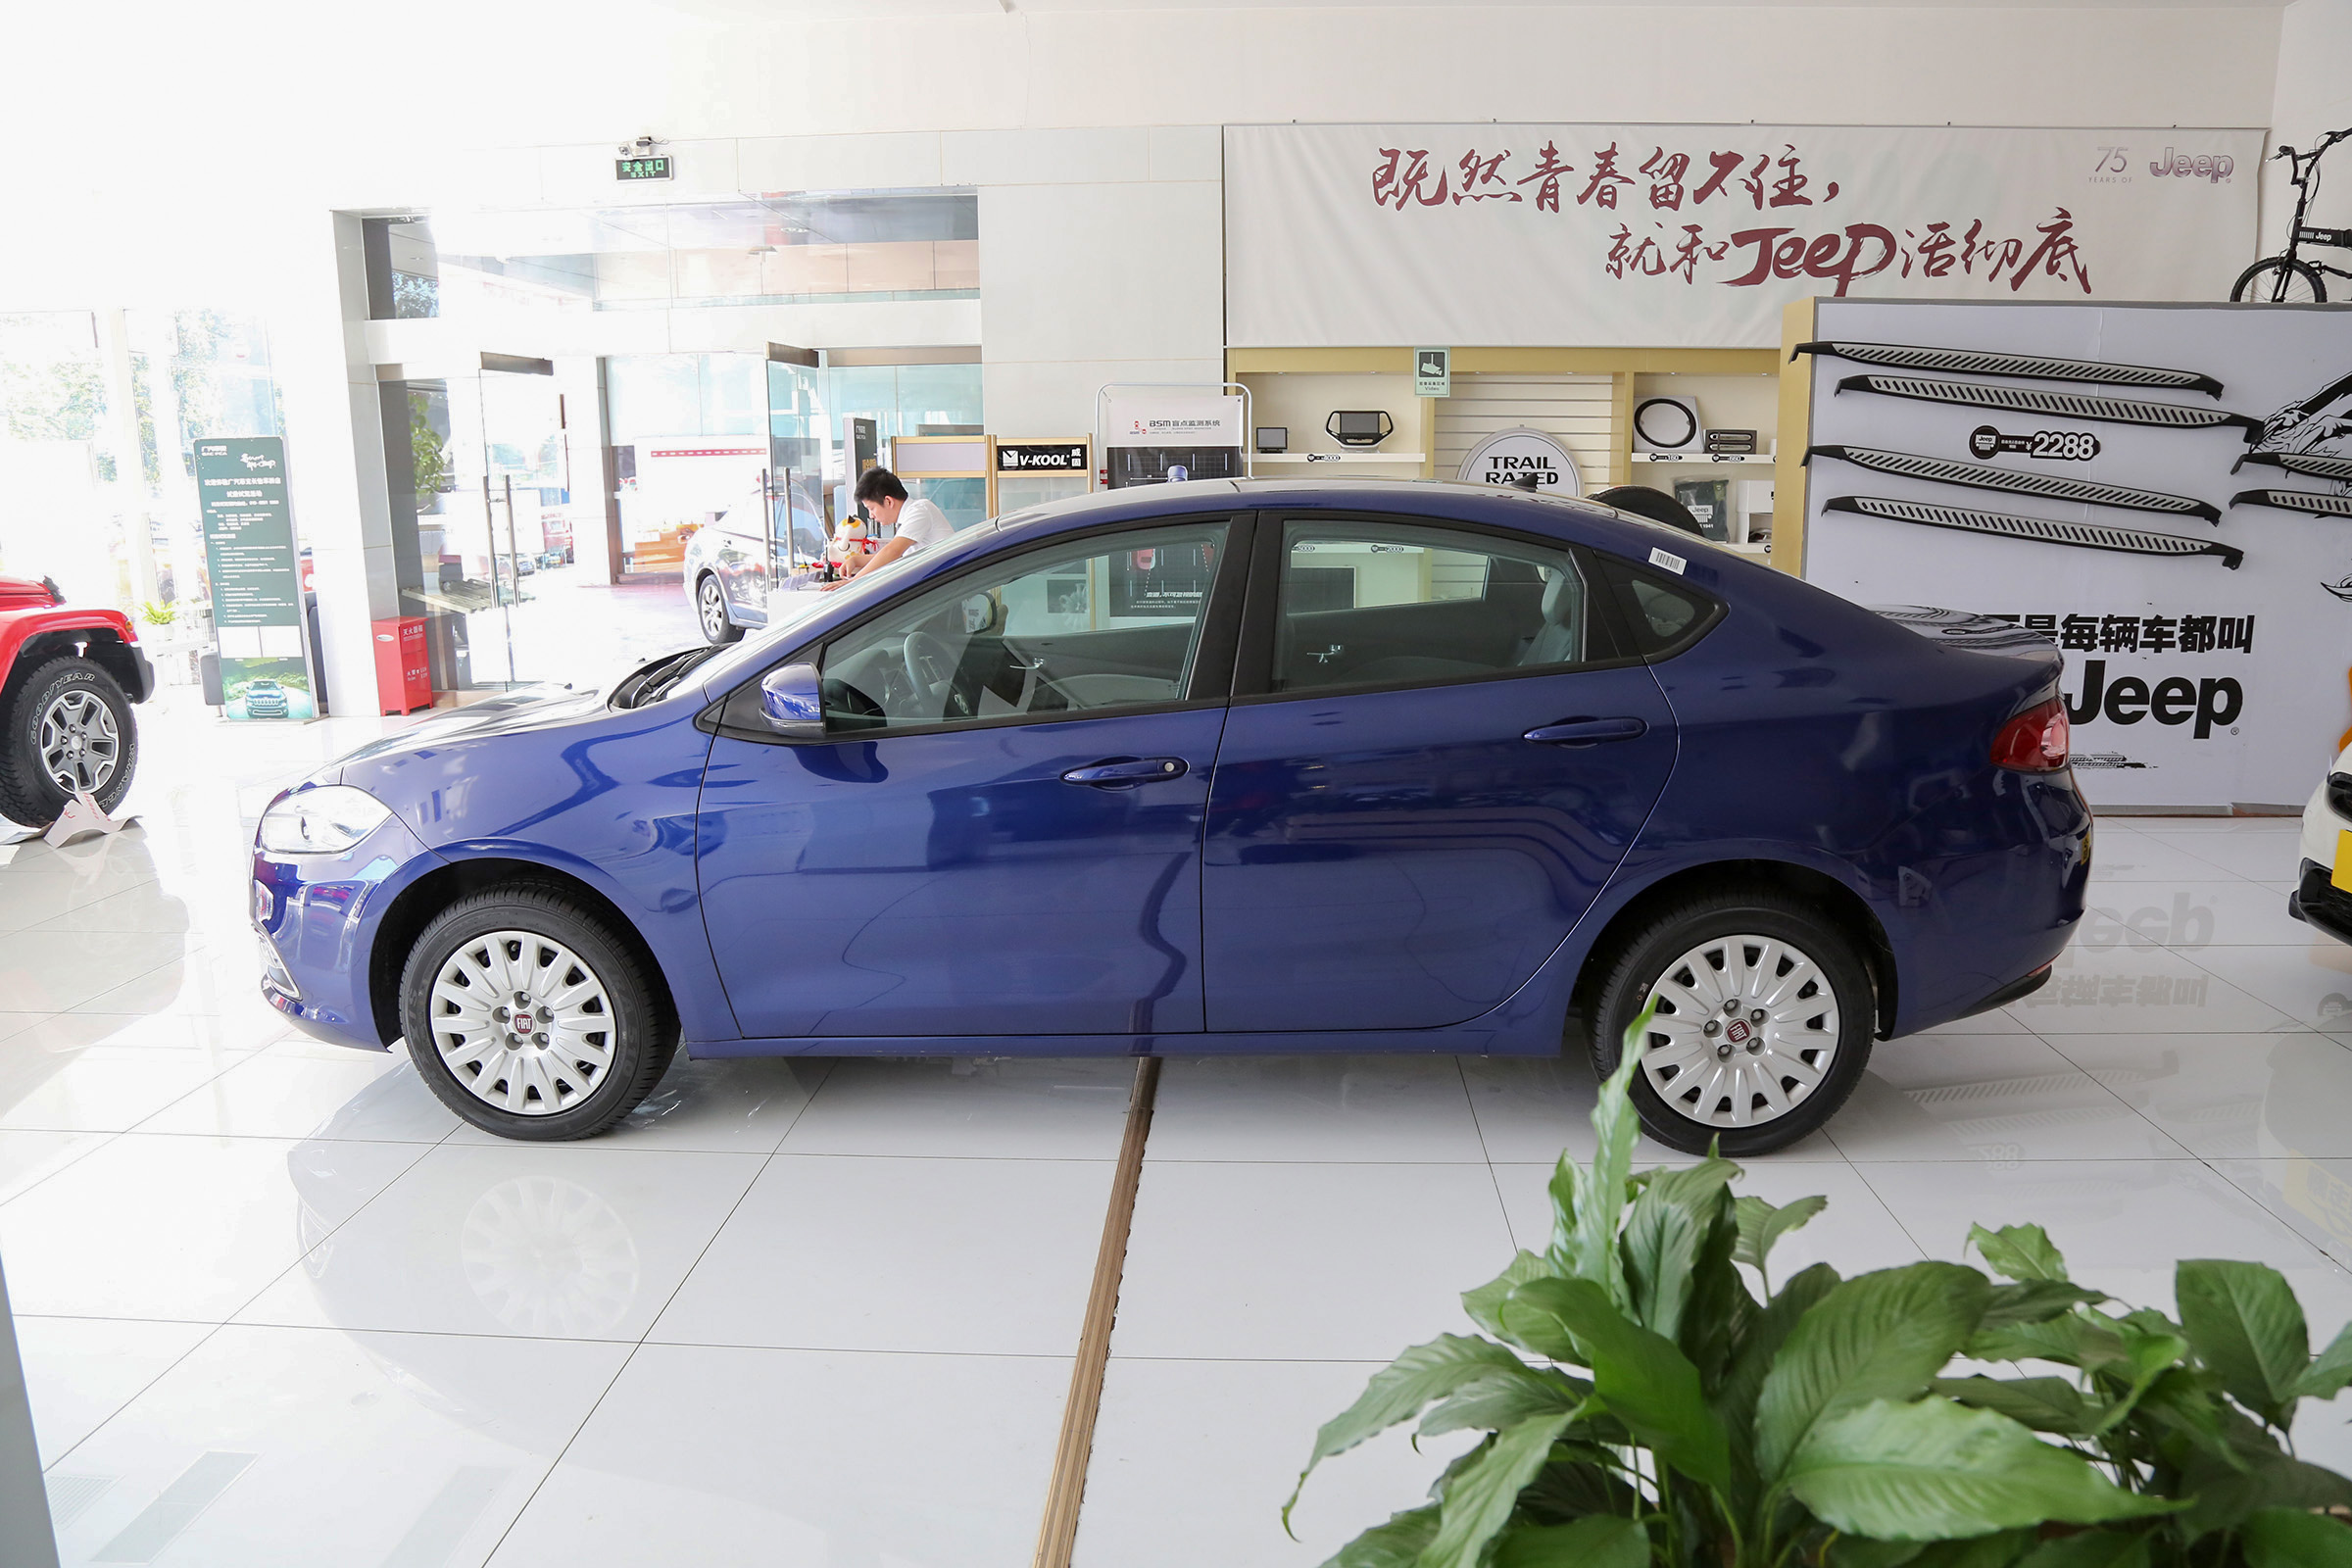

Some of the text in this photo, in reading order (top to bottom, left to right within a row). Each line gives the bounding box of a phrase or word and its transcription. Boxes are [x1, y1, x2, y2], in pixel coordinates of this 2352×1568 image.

[621, 159, 664, 172] 安全出口
[2095, 146, 2129, 173] 75
[2149, 147, 2234, 183] Jeep
[2315, 231, 2332, 242] Jeep
[1019, 454, 1067, 466] V-KOOL
[1488, 457, 1556, 469] TRAIL
[1984, 613, 2255, 654] 是每辆车都叫
[30, 672, 96, 745] GOODYEAR
[2064, 660, 2244, 740] Jeep
[98, 743, 135, 808] WRANGL
[516, 1017, 532, 1030] FIAT
[1730, 1023, 1747, 1041] FIAT
